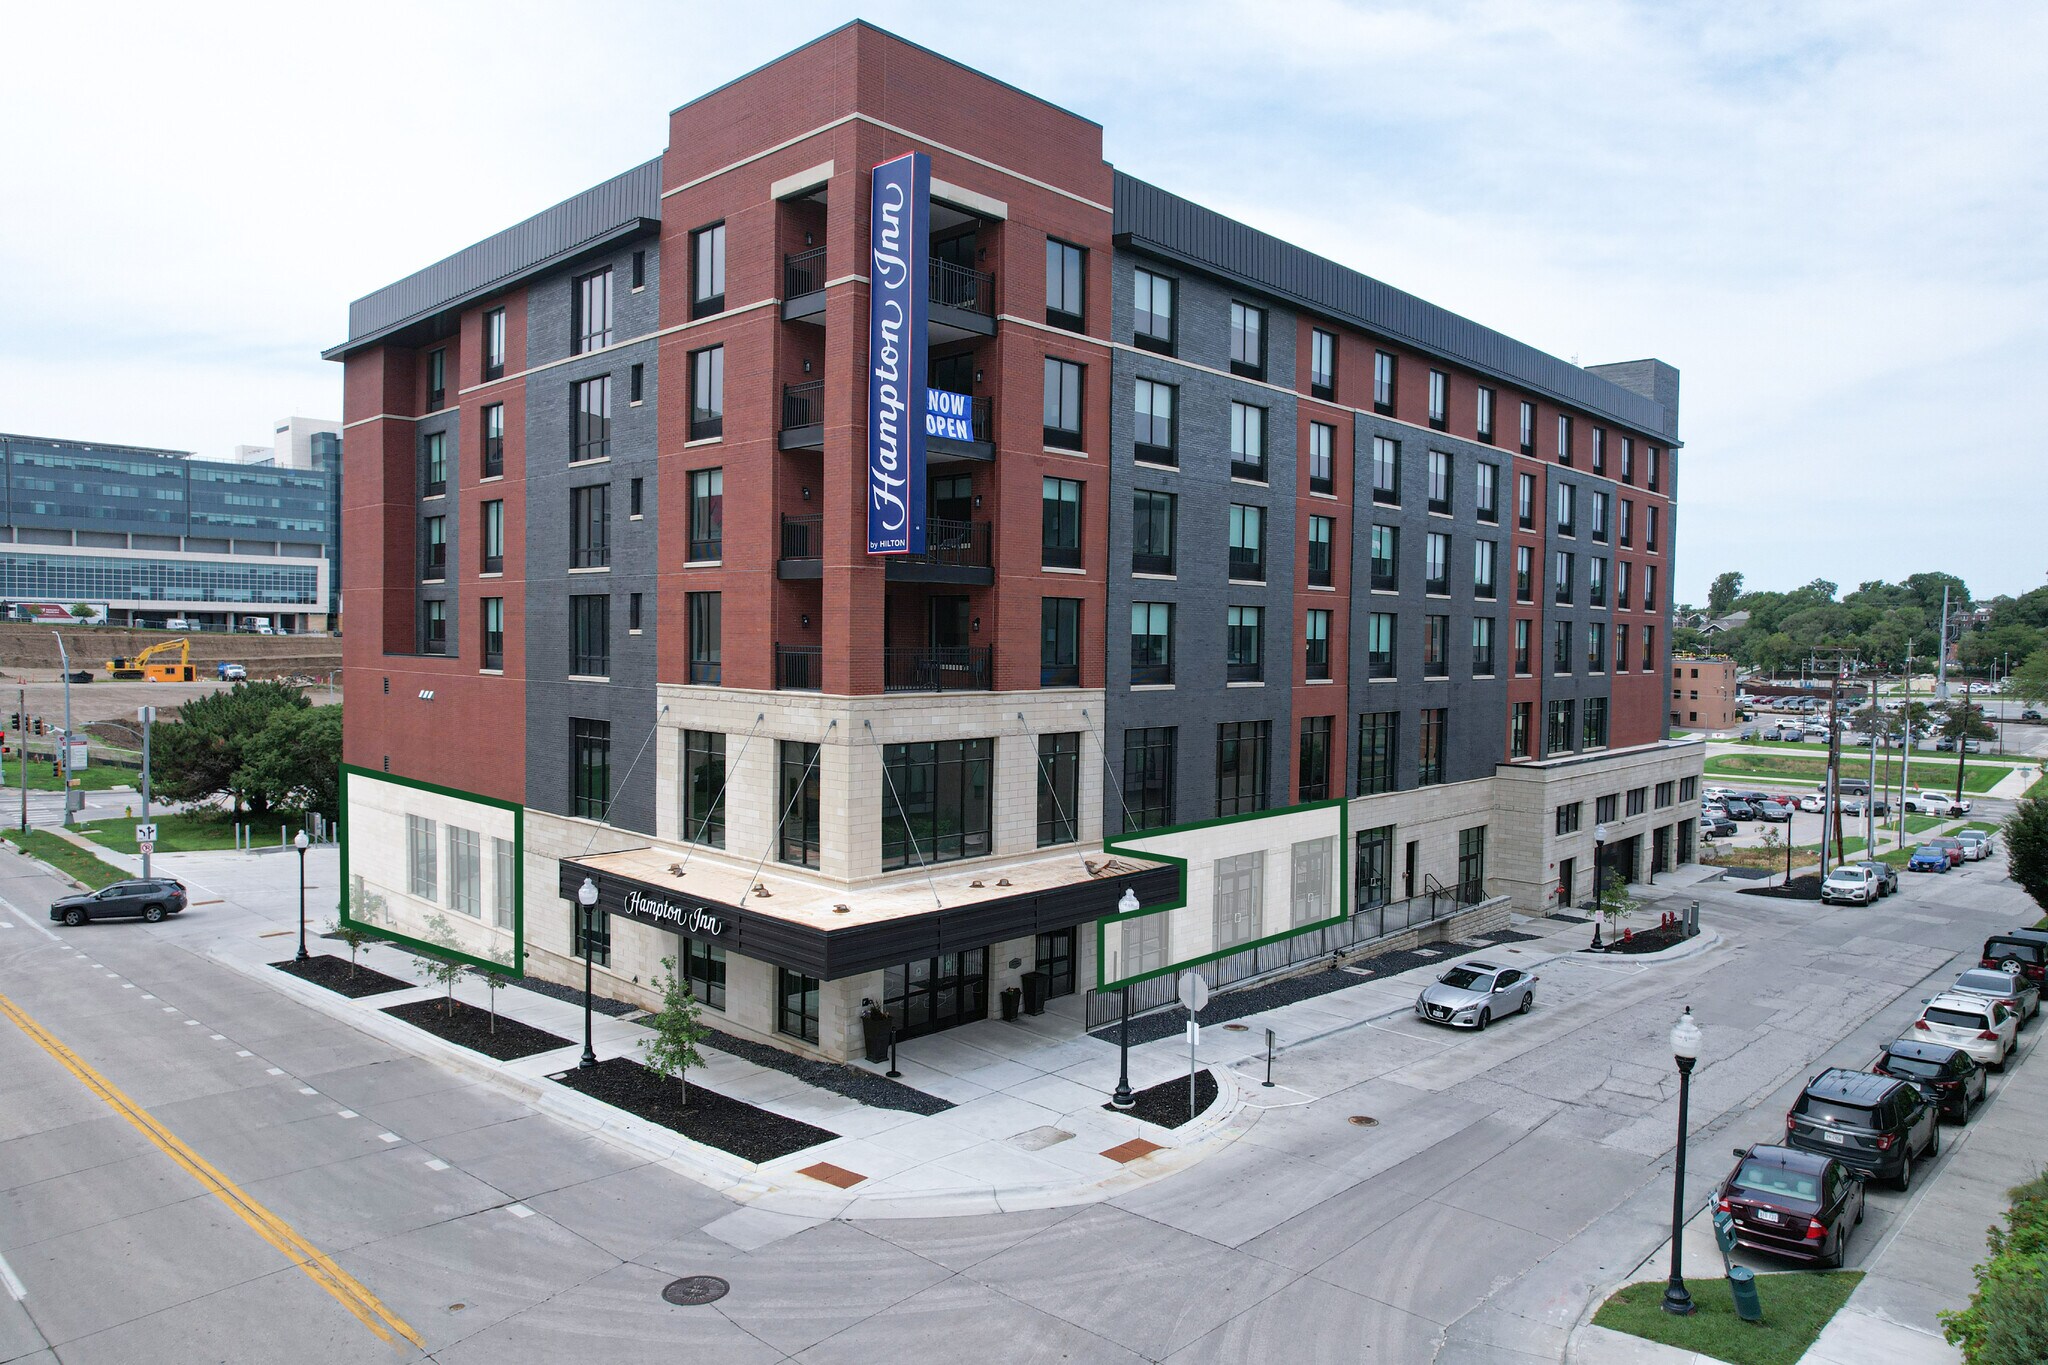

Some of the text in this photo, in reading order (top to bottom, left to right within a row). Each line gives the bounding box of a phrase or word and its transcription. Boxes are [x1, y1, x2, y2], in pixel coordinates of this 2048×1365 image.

[871, 182, 907, 531] Hampton Inn
[928, 389, 965, 416] NOW
[926, 413, 968, 440] OPEN
[870, 538, 906, 550] by HILTON
[624, 891, 722, 936] Hampton Inn
